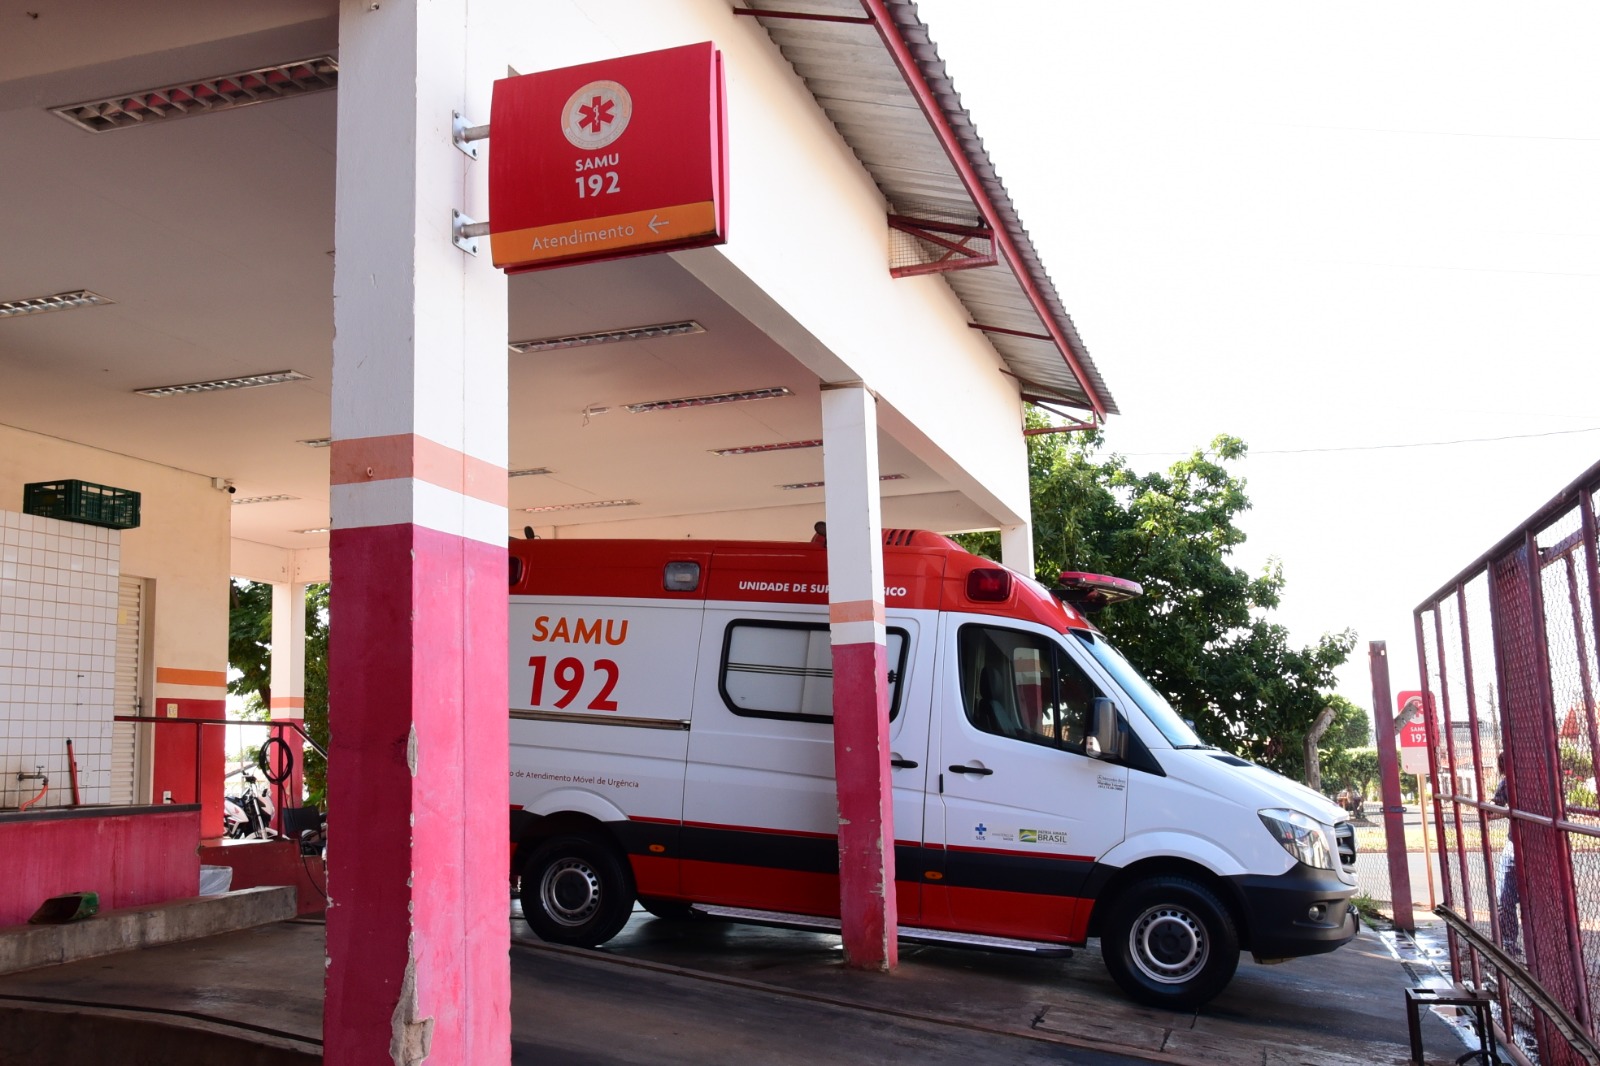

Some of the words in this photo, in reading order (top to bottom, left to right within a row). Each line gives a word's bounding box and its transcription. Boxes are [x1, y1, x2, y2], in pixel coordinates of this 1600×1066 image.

[575, 153, 619, 172] SAMU
[575, 172, 621, 199] 192
[532, 224, 634, 250] Atendimento
[738, 581, 790, 592] UNIDADE
[792, 583, 807, 593] DE
[884, 586, 907, 597] ICO
[532, 615, 629, 646] SAMU
[528, 655, 620, 712] 192
[1410, 733, 1427, 743] 192
[515, 770, 525, 778] de
[525, 771, 572, 783] Atendimento
[572, 775, 596, 785] Móvel
[596, 778, 607, 786] de
[607, 778, 640, 789] Urgência
[1037, 833, 1069, 844] BRASIL
